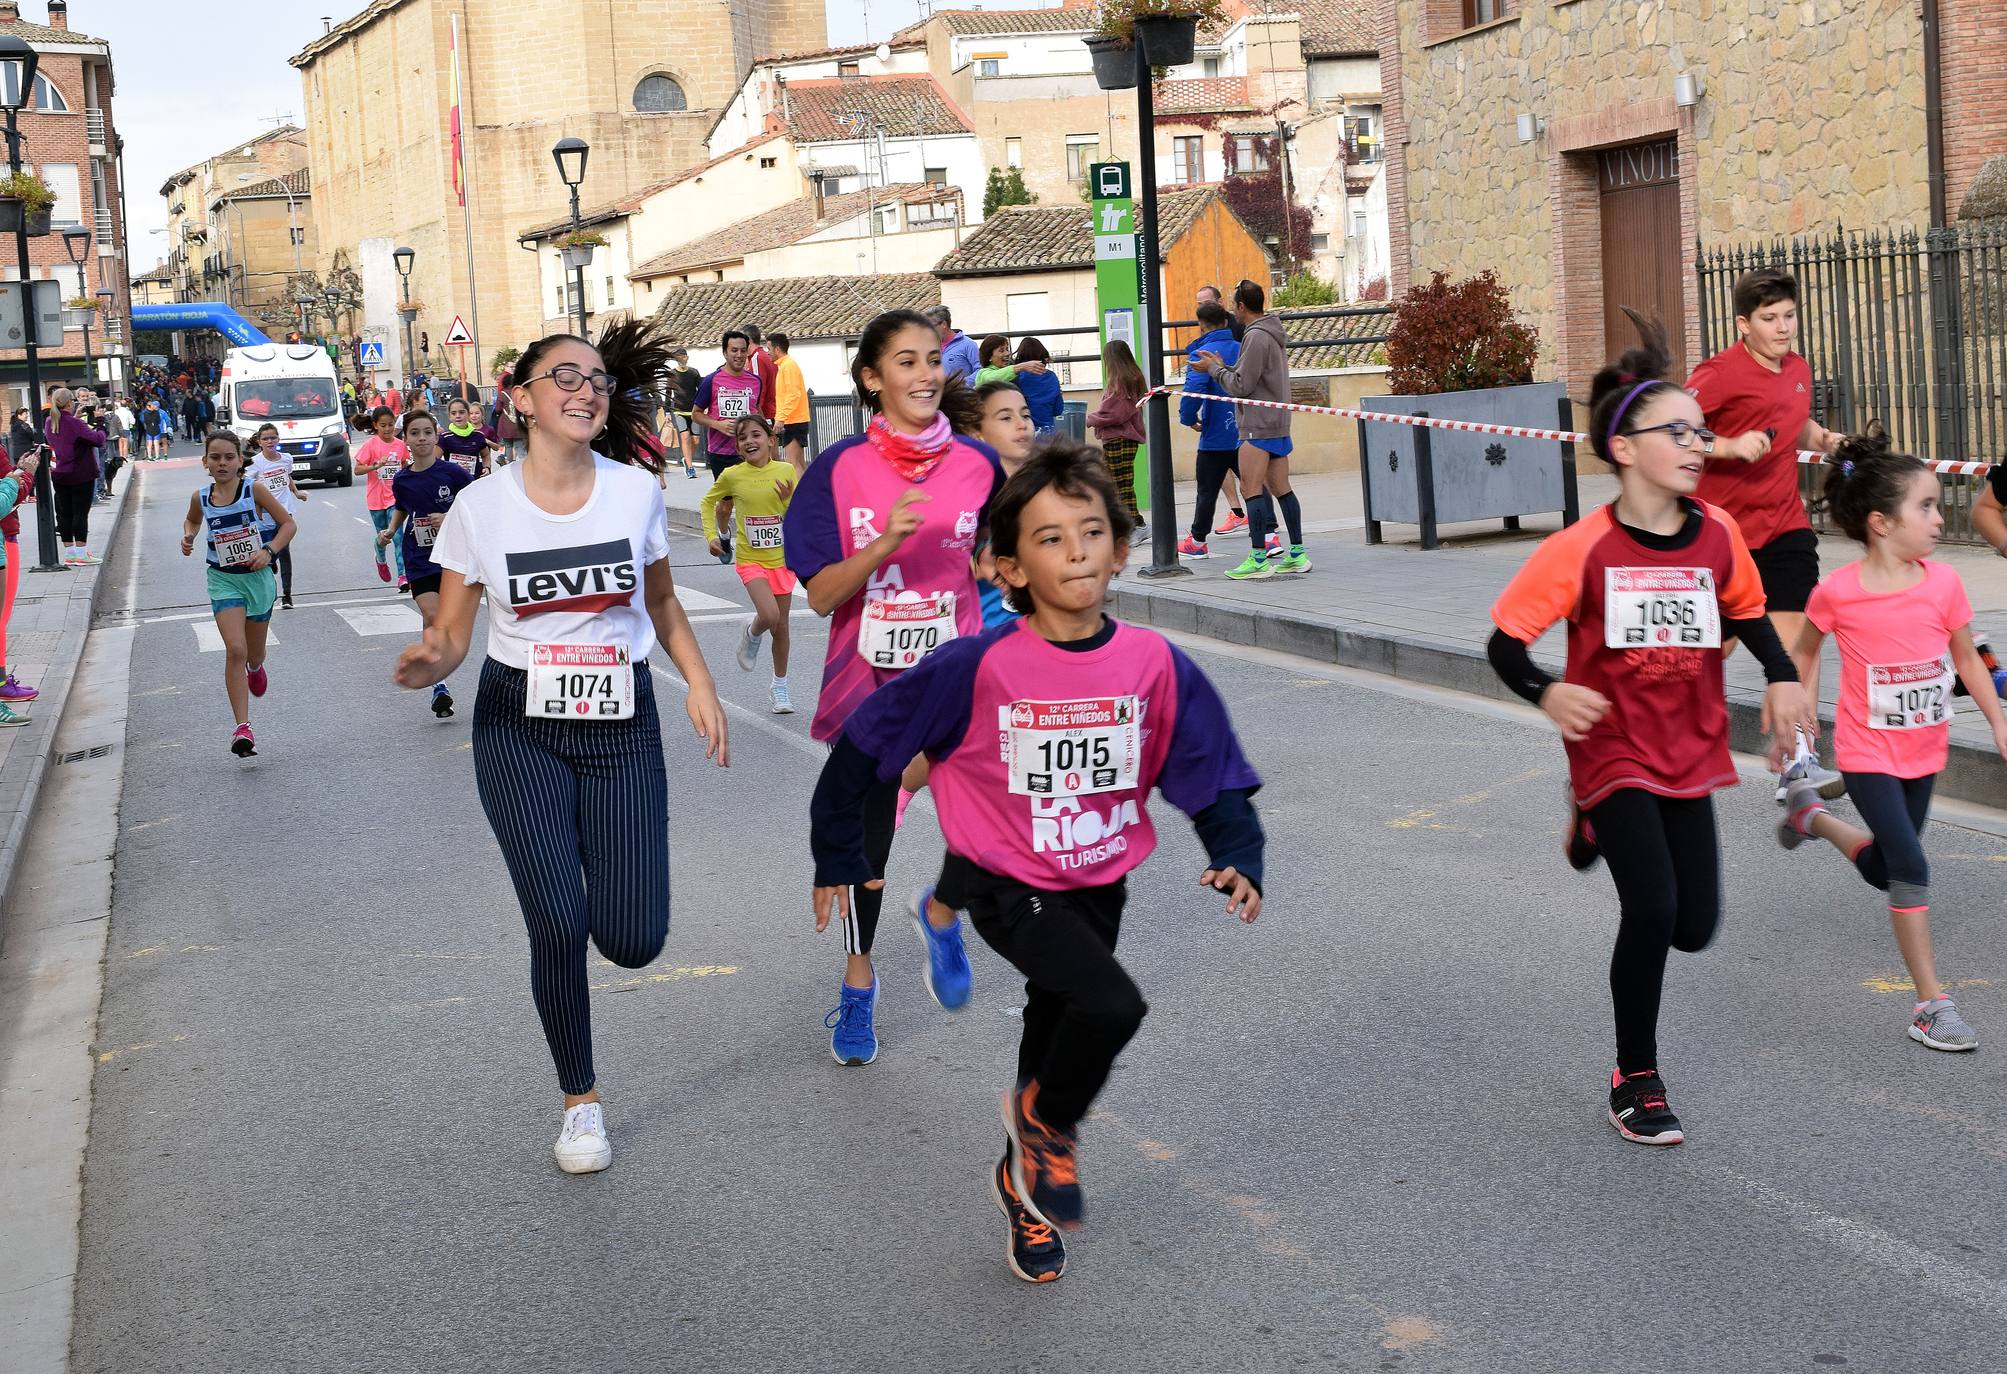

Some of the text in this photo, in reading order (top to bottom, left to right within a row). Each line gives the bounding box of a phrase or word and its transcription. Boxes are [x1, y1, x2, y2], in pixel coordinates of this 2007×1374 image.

[1108, 243, 1122, 252] M1
[724, 399, 743, 411] 672
[424, 527, 438, 538] 10
[753, 527, 780, 540] 1062
[225, 540, 253, 556] 1005
[1634, 599, 1698, 626] 1036
[885, 626, 938, 650] 1070
[556, 653, 580, 664] ENTRE
[556, 673, 613, 698] 1074
[1062, 702, 1100, 714] CARRERA
[1893, 684, 1944, 713] 1072
[1039, 710, 1111, 726] ENTRE VIÑEDOS
[1038, 736, 1110, 772] 1015
[1031, 796, 1083, 818] LA
[1032, 799, 1141, 853] RIOJA
[1056, 835, 1128, 871] TURISMO
